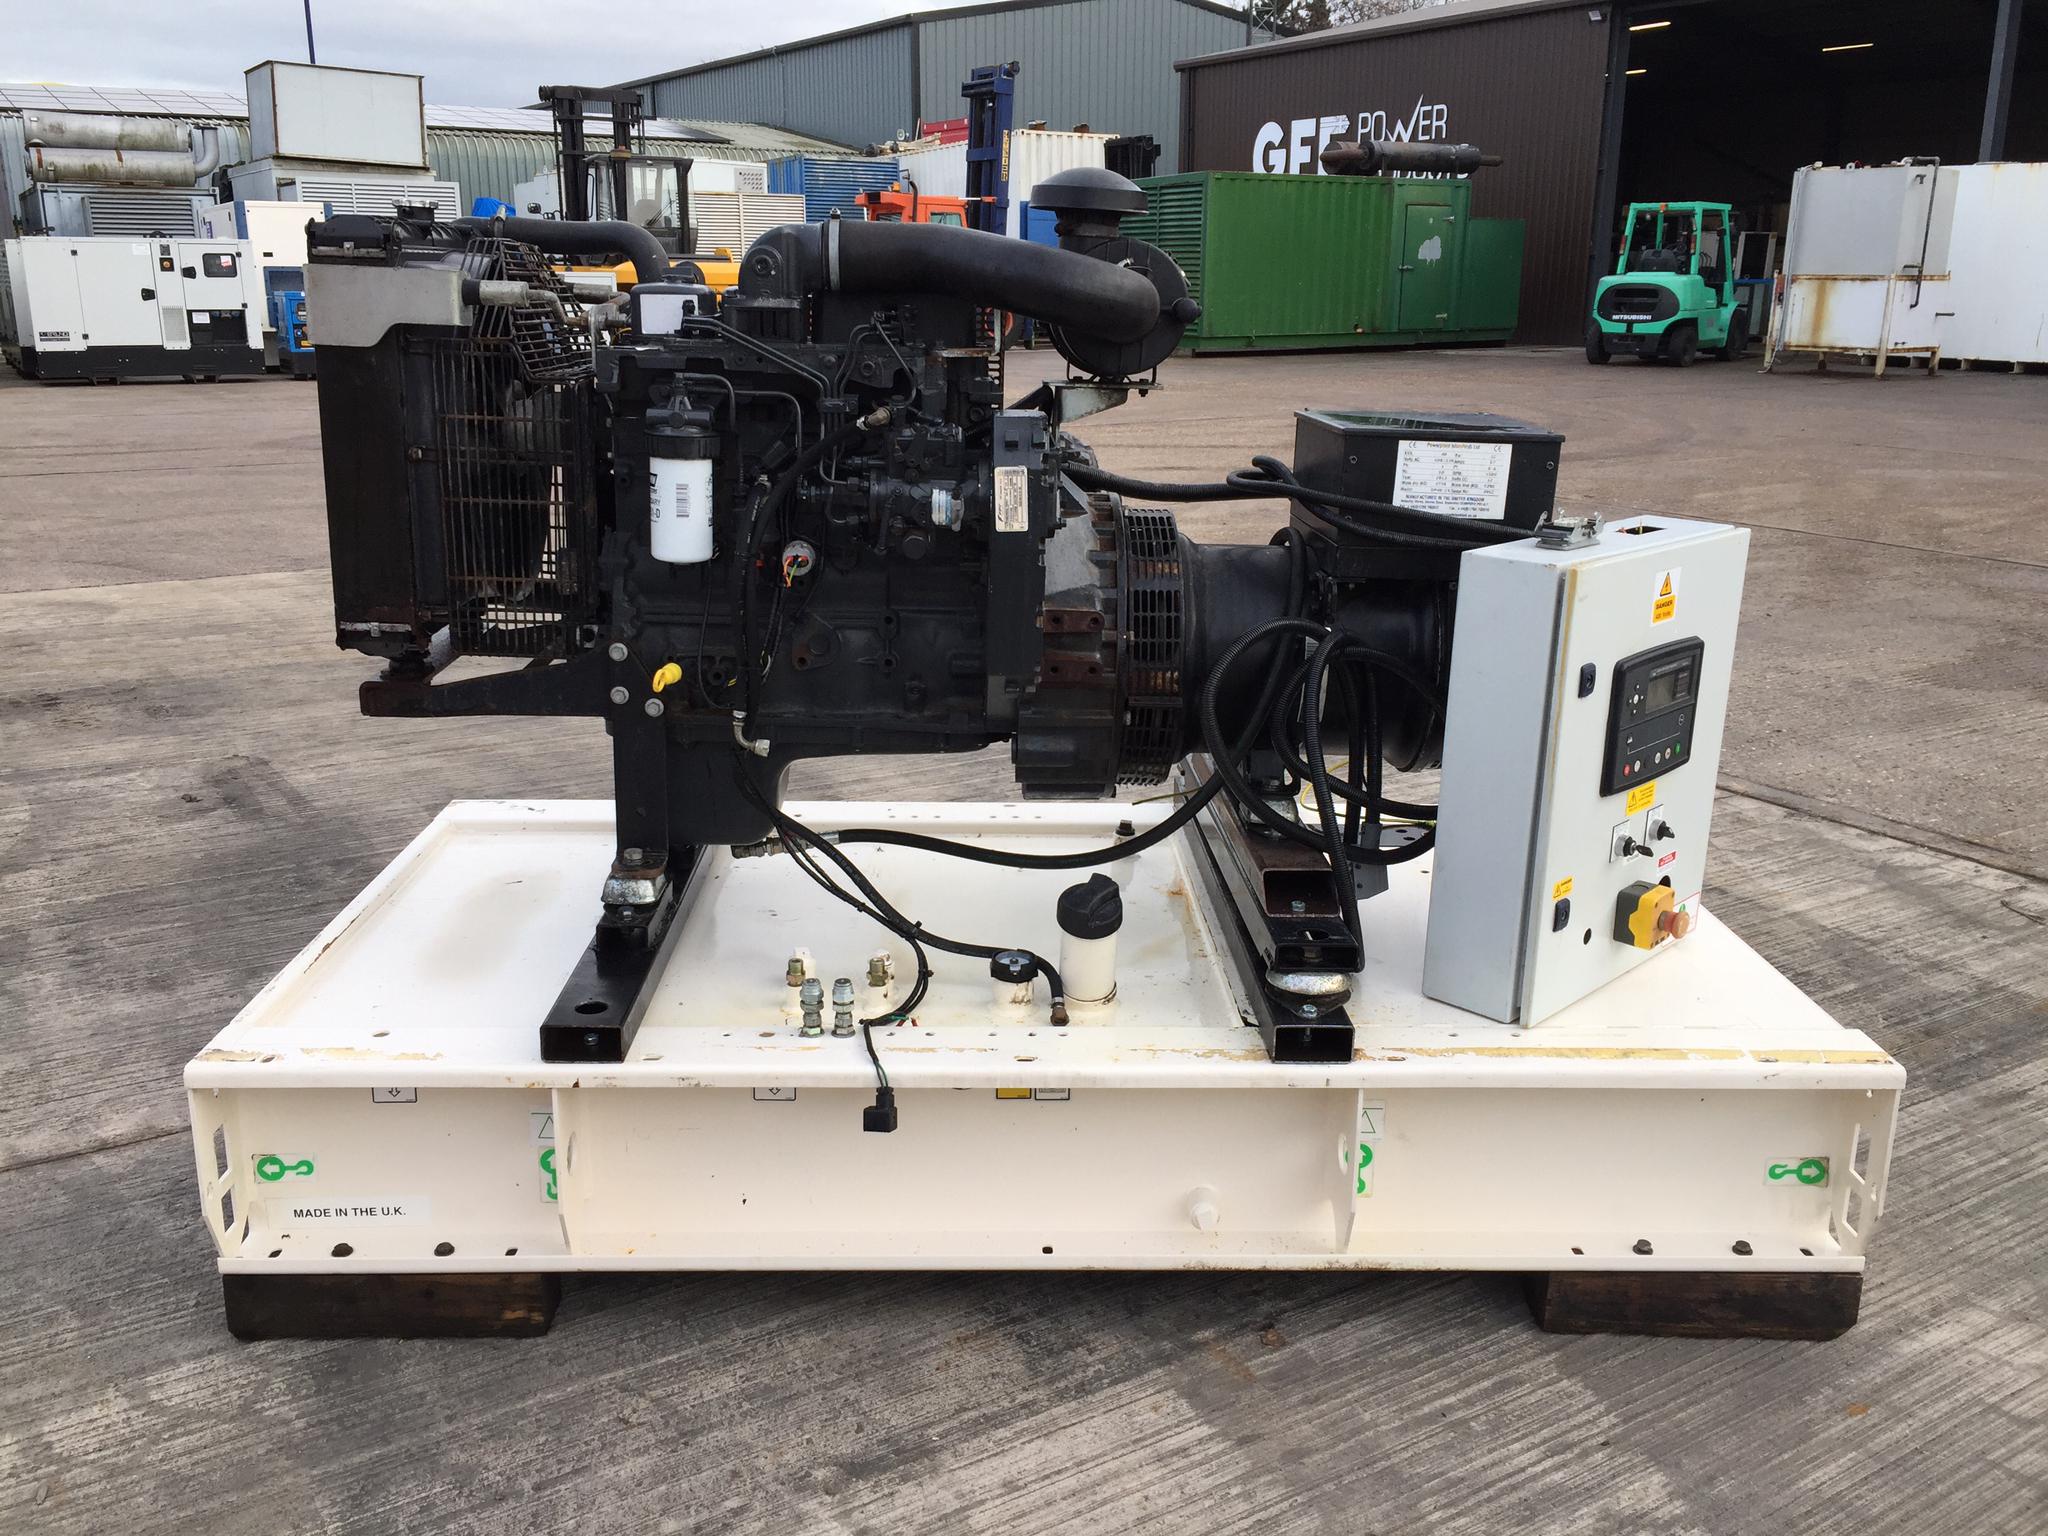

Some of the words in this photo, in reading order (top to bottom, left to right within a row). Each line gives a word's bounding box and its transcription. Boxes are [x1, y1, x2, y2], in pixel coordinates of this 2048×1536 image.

[1357, 94, 1448, 144] POWER
[293, 1208, 332, 1218] MADE
[335, 1208, 348, 1217] IN
[351, 1207, 378, 1217] THE
[381, 1206, 406, 1216] U.K.
